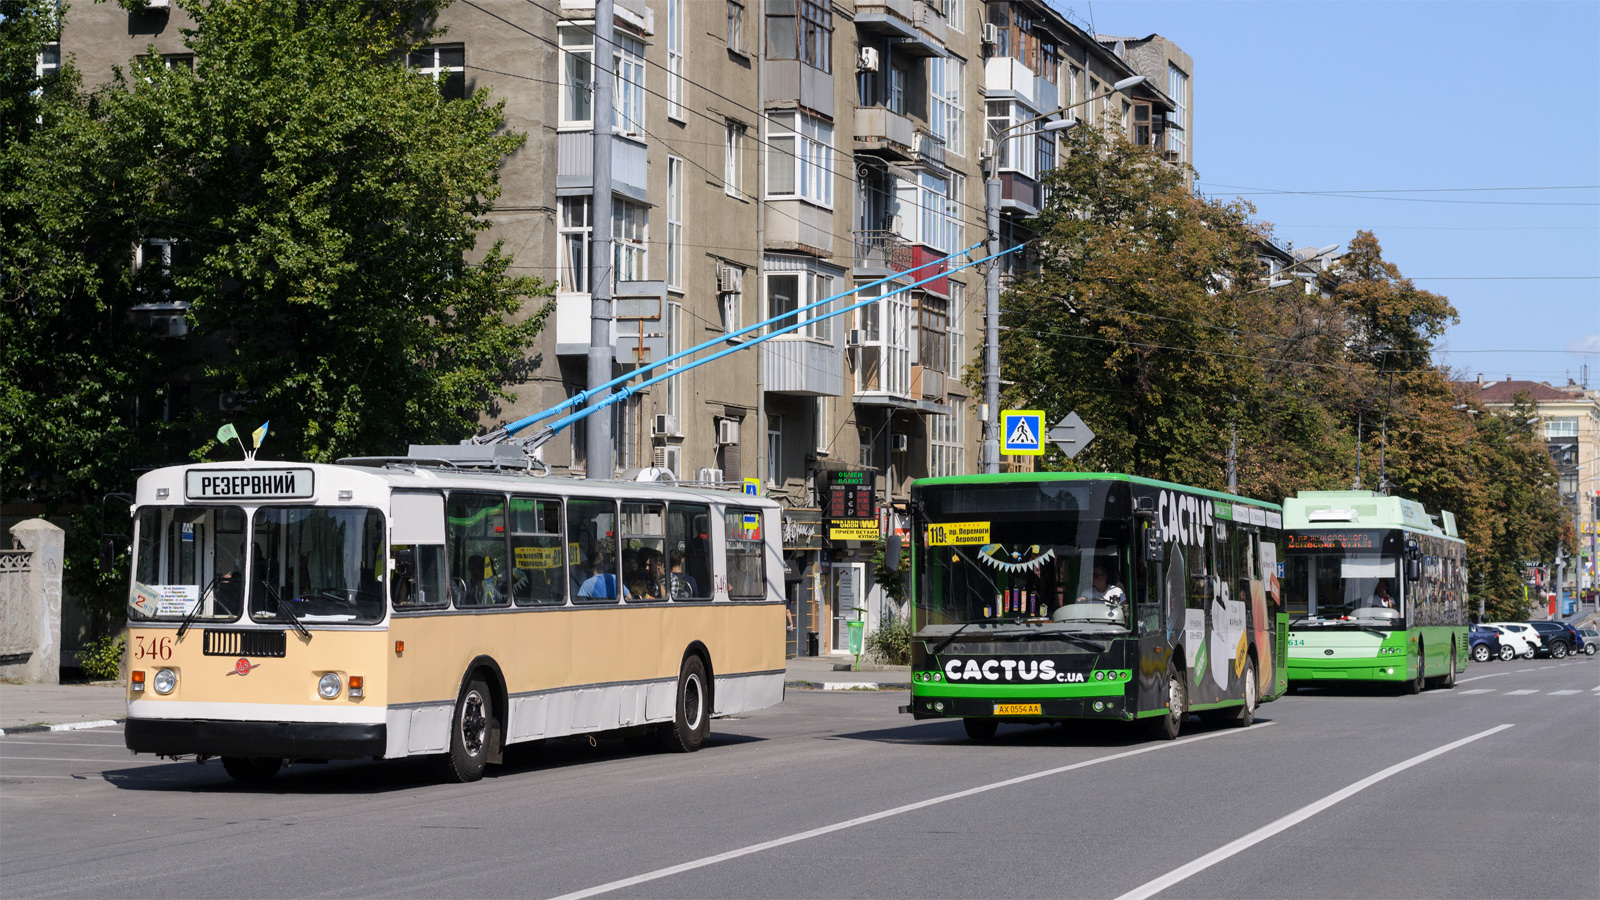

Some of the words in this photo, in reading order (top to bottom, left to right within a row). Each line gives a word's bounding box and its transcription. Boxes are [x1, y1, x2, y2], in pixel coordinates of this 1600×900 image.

[202, 471, 295, 495] РЕЗЕРВНИЙ
[1158, 490, 1213, 548] CACTUS
[1288, 535, 1295, 548] 2
[135, 594, 146, 608] 2
[134, 636, 172, 660] 346
[945, 659, 1057, 680] CACTUS
[1056, 673, 1085, 682] C.UA
[999, 705, 1010, 713] AX
[1011, 705, 1027, 713] 0554
[1028, 705, 1039, 713] AA
